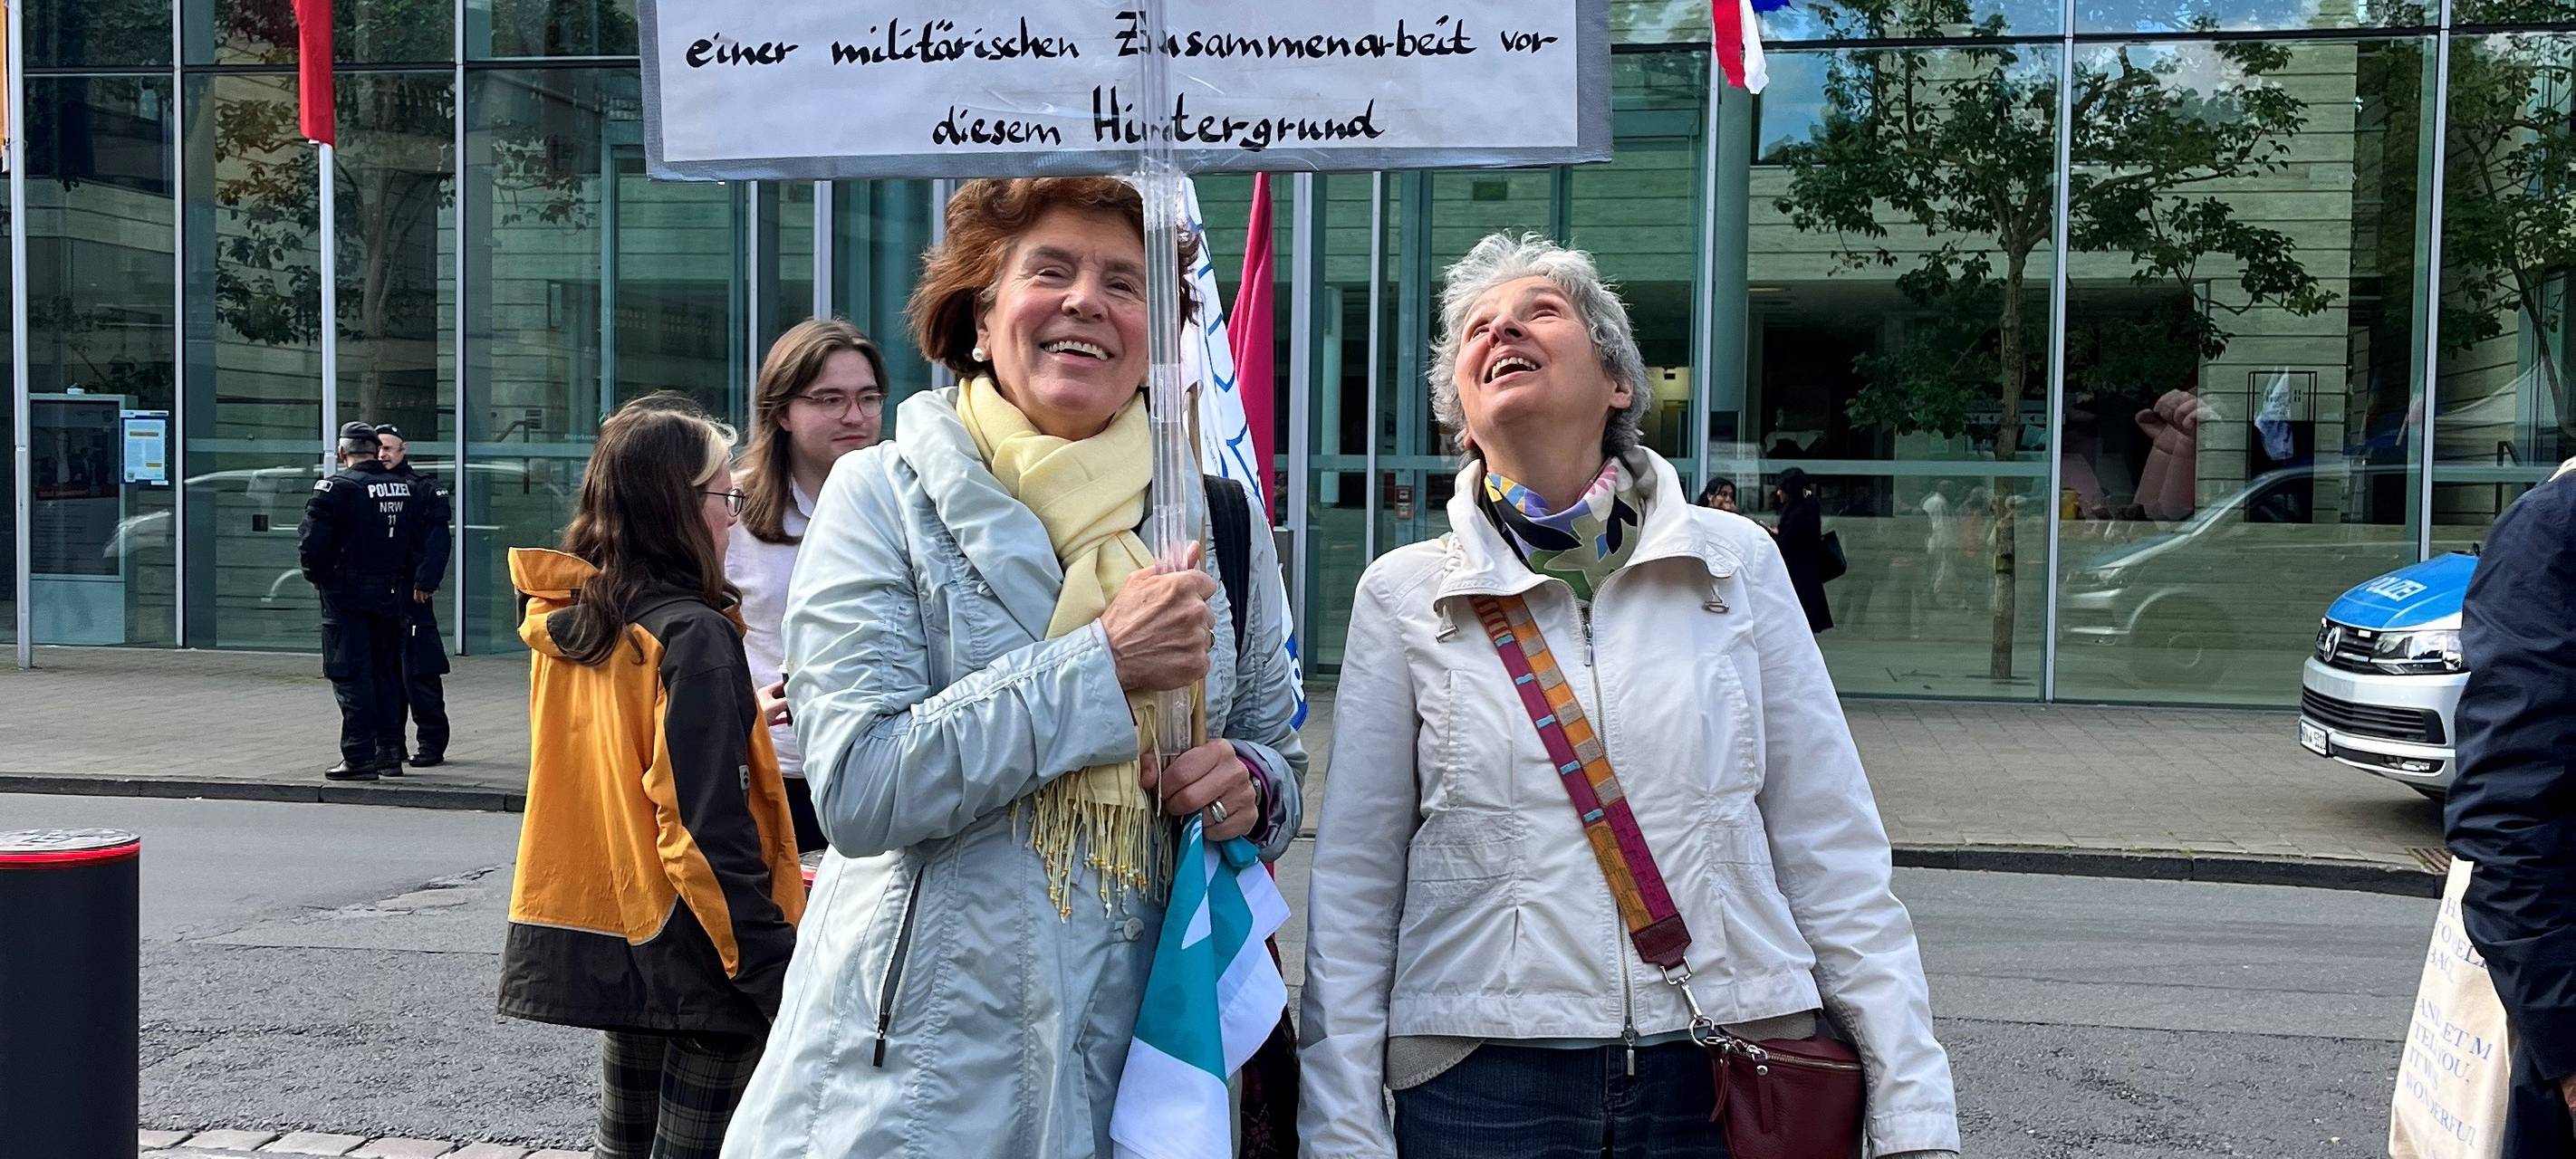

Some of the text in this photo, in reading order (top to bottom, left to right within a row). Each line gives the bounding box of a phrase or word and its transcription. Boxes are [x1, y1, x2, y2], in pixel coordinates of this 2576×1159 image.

[686, 10, 1559, 68] einer militärischen Zusammenarbeit vor
[932, 84, 1385, 152] diesem Hintergrund
[367, 483, 411, 499] POLIZEI
[380, 501, 404, 513] NRW
